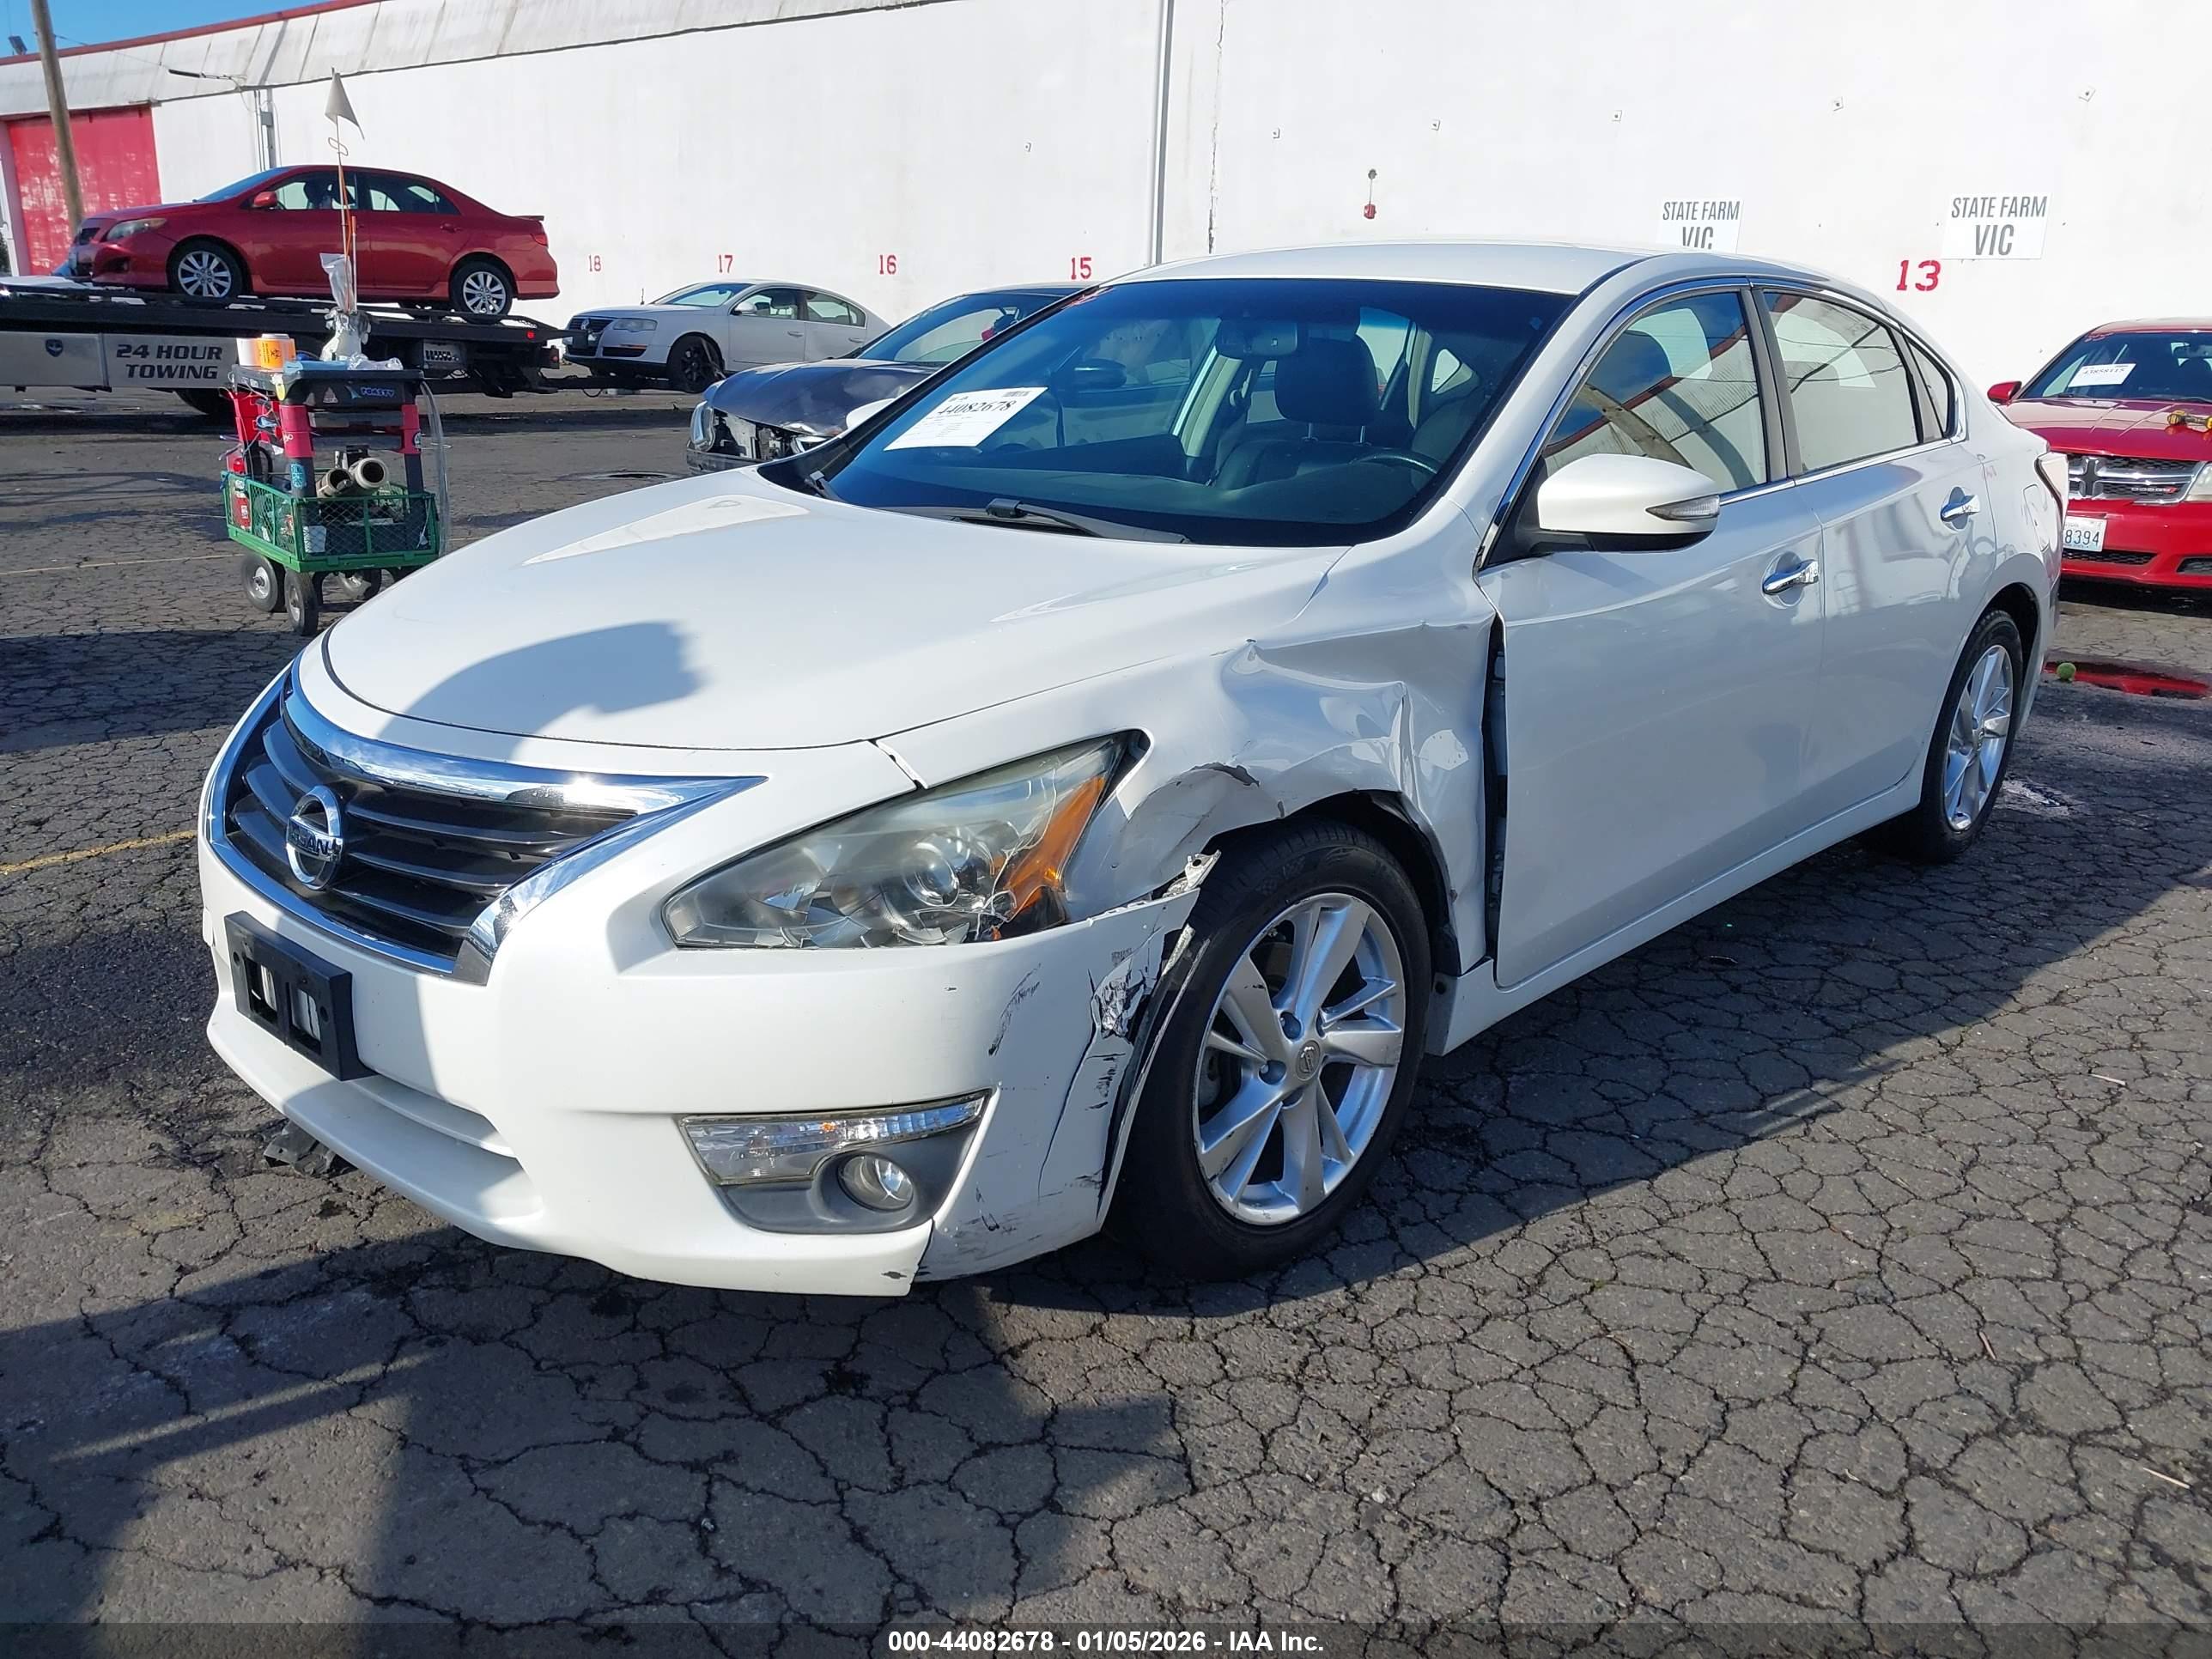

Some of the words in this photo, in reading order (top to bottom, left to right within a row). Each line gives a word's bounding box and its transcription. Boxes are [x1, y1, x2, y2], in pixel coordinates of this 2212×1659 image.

[1662, 201, 1699, 221] STATE
[1701, 200, 1741, 220] FARM
[1951, 197, 1996, 218] STATE
[1999, 196, 2048, 217] FARM
[1682, 226, 1714, 250] VIC
[1975, 224, 2014, 256] VIC
[588, 254, 602, 272] 18
[718, 254, 733, 273] 17
[879, 254, 897, 275] 16
[1071, 257, 1092, 280] 15
[1896, 259, 1942, 292] 13
[116, 343, 149, 359] 24
[156, 345, 222, 360] HOUR
[125, 364, 218, 379] TOWING
[289, 820, 331, 855] SSAN
